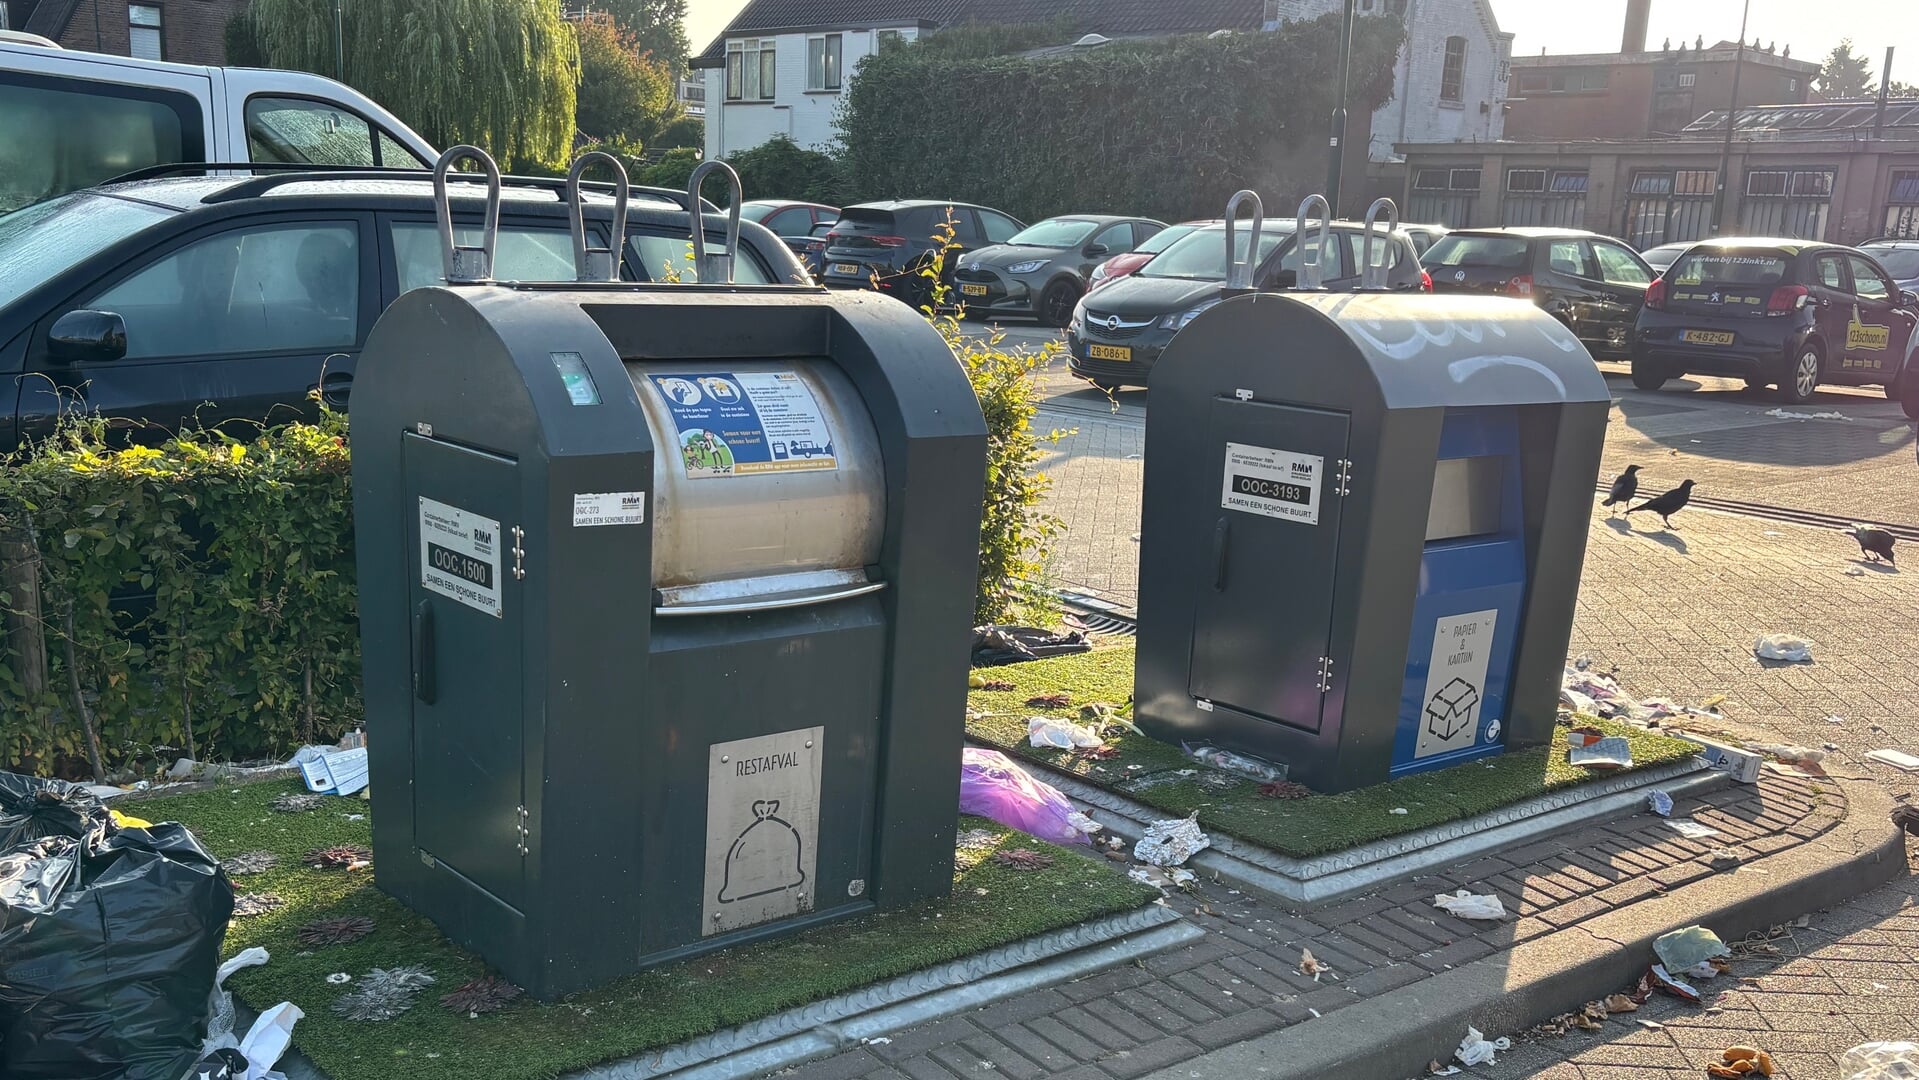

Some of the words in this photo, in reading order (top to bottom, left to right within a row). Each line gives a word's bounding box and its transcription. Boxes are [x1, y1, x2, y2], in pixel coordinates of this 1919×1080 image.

[1732, 257, 1777, 265] 123inkt.nl
[1849, 330, 1888, 344] 123schoon.nl
[1091, 346, 1128, 360] ZB-086-L
[1241, 478, 1300, 500] OOC-3193
[1228, 497, 1249, 508] SAMEN
[1250, 500, 1262, 509] EEN
[1263, 503, 1289, 515] SCHONE
[1290, 507, 1312, 518] BUURT
[574, 517, 592, 525] SAMEN
[593, 516, 604, 524] EEN
[604, 516, 624, 524] SCHONE
[625, 515, 642, 523] BUURT
[435, 548, 486, 583] OOC.1500
[426, 573, 444, 587] SAMEN
[444, 580, 455, 592] EEN
[456, 584, 477, 601] SCHONE
[478, 593, 496, 608] BUURT
[1453, 622, 1477, 638] PAPIER
[1460, 638, 1466, 650] &
[1448, 650, 1474, 666] KARTON
[736, 751, 799, 777] RESTAFVAL
